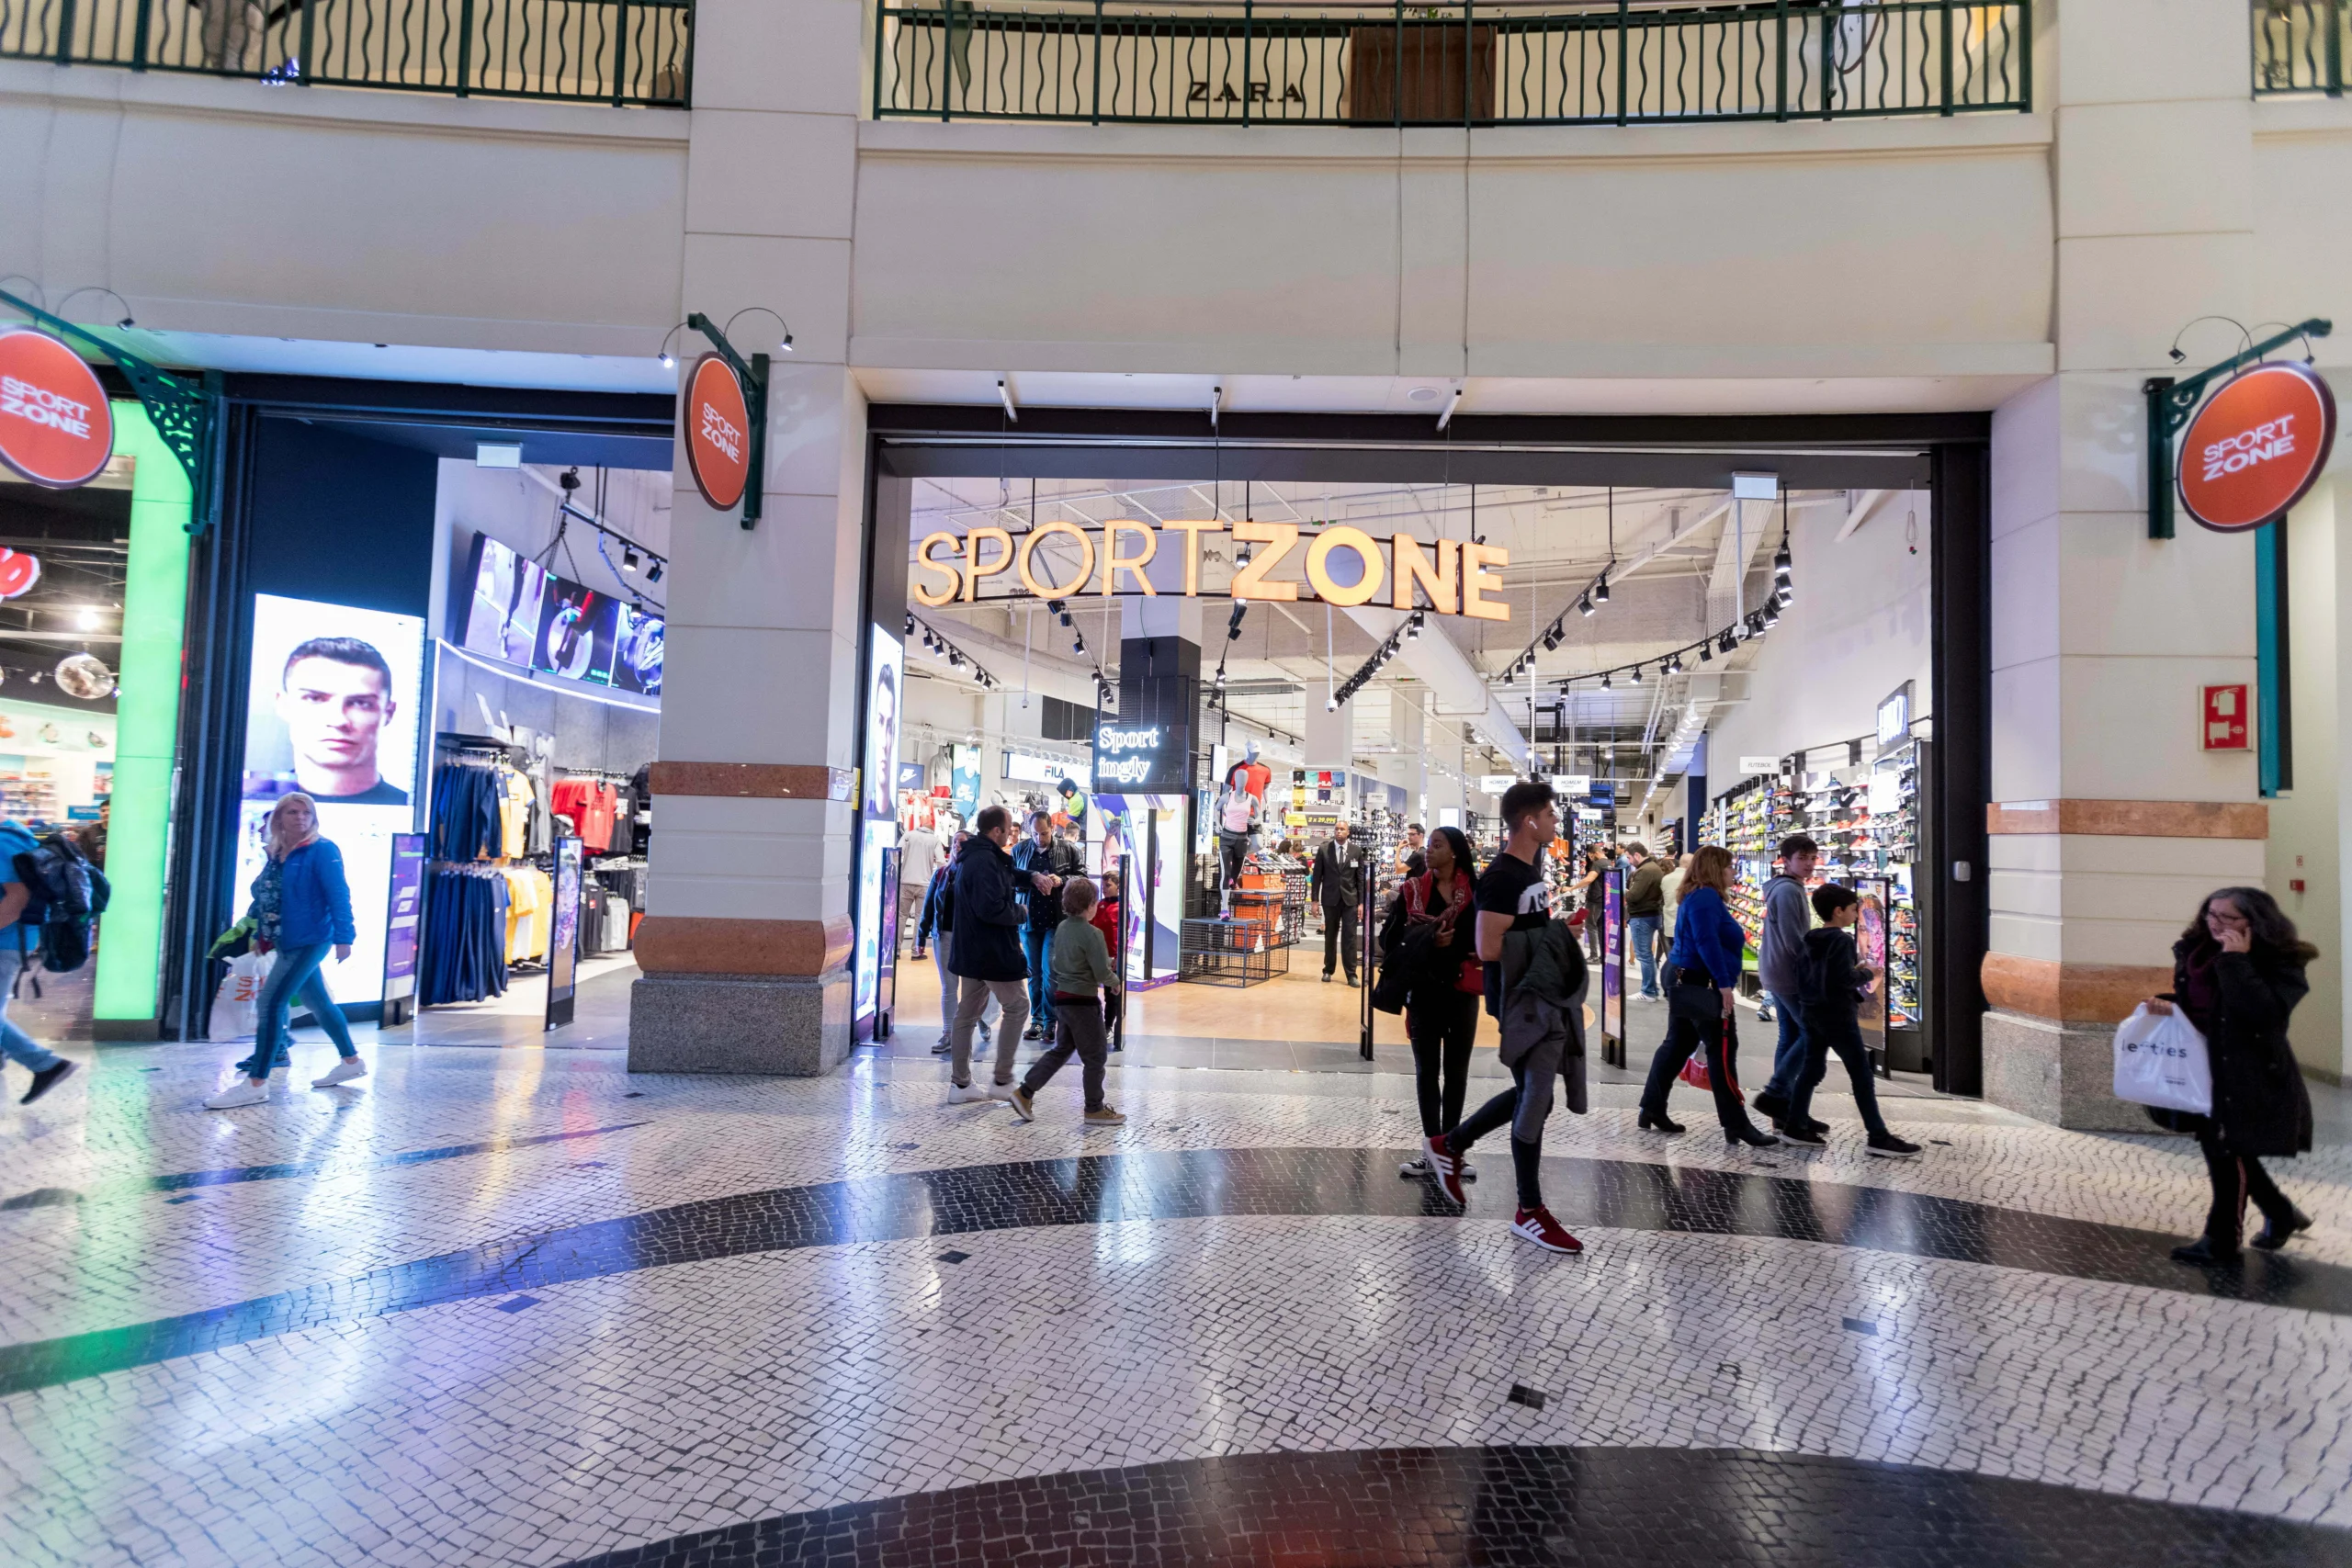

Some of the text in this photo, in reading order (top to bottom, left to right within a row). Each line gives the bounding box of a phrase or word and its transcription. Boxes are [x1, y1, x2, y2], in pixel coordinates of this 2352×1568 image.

[1189, 81, 1303, 103] ZARA
[1, 394, 91, 440] ZONE
[2, 375, 91, 421] SPORT
[701, 419, 741, 465] ZONE
[703, 401, 741, 446] SPORT
[2203, 413, 2295, 463] SPORT
[2202, 434, 2295, 482] ZONE
[1099, 727, 1159, 754] Sport
[1045, 765, 1065, 779] FILA
[1098, 755, 1151, 784] ingly
